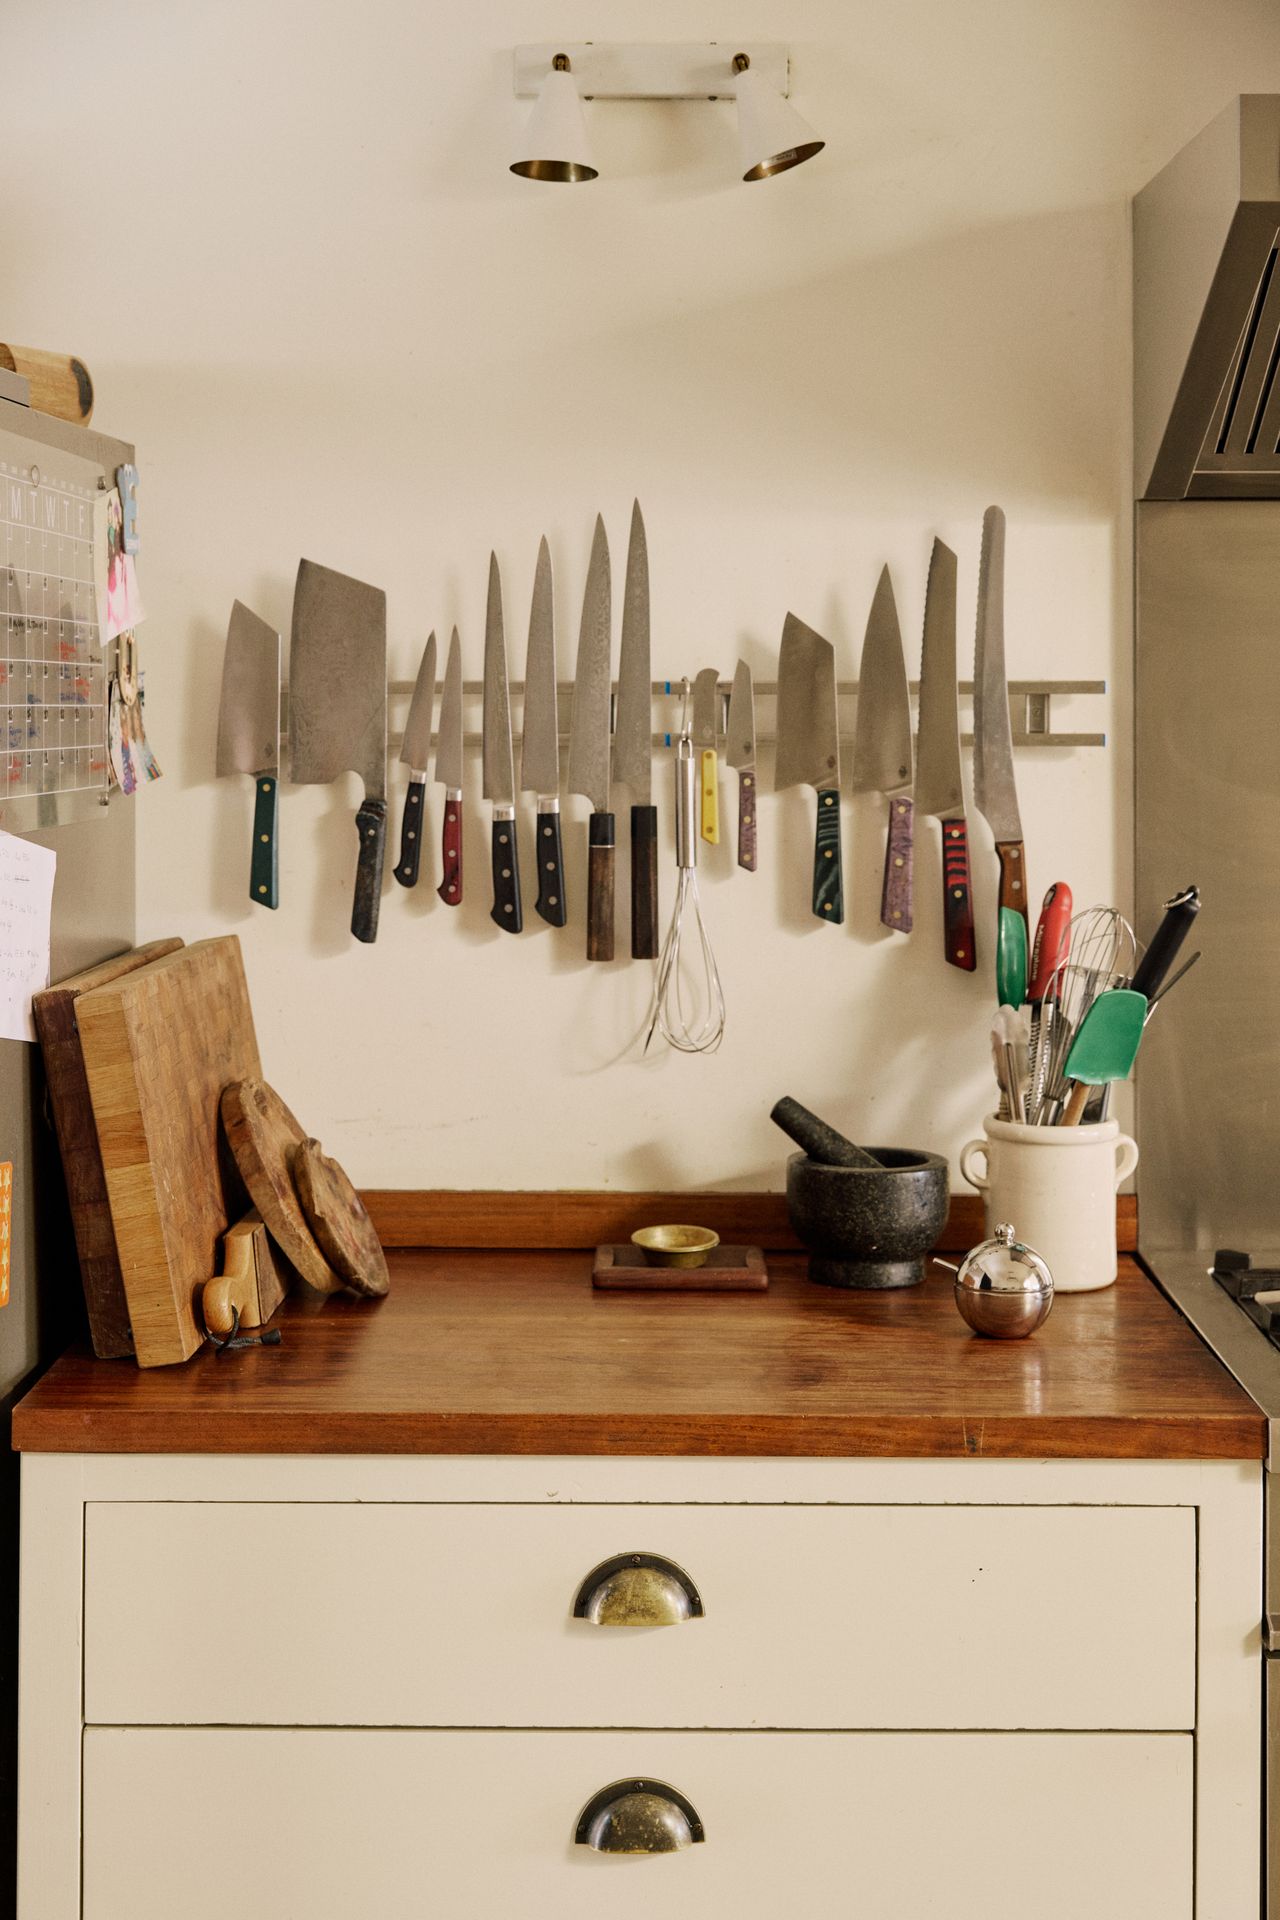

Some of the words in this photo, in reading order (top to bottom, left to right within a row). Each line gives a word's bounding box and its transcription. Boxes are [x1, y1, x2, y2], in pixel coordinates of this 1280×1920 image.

[30, 491, 37, 525] T
[63, 500, 70, 531] T
[1032, 925, 1044, 980] Microplane
